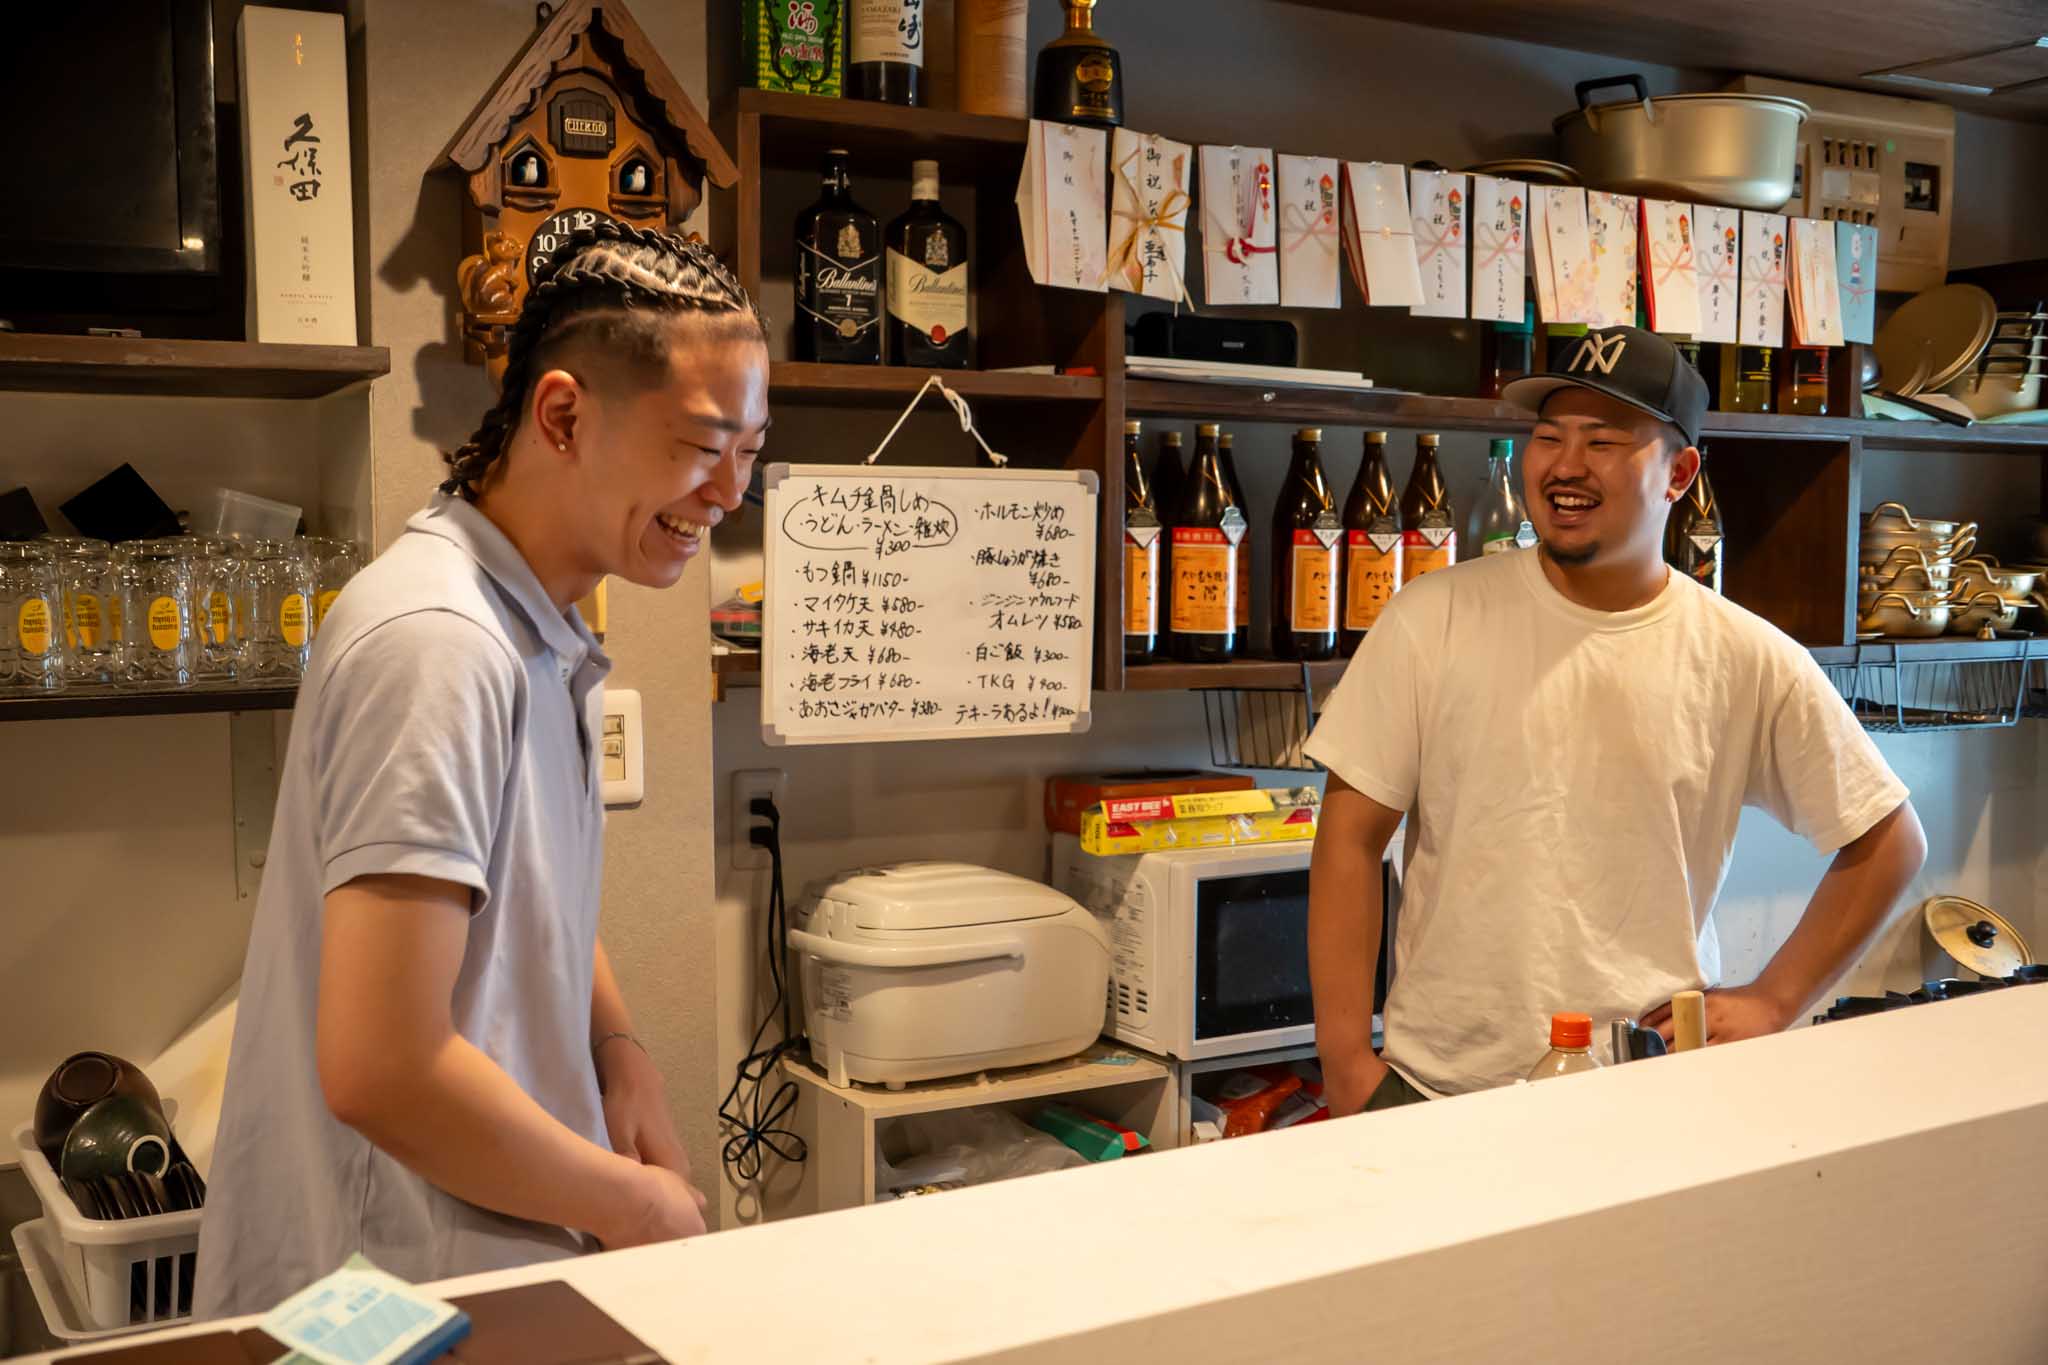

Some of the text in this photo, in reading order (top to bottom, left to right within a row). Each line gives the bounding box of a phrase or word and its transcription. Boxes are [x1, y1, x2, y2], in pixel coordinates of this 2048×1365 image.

[277, 112, 321, 202] 久保田
[1146, 147, 1162, 190] 御祝
[553, 216, 570, 235] 11
[573, 211, 596, 230] 12
[537, 234, 557, 253] 10
[810, 484, 930, 514] キムチ鍋しめ
[980, 501, 1065, 522] ホルモン炒め
[802, 560, 856, 586] もつ鍋
[804, 592, 874, 615] マイタケ天
[803, 618, 874, 639] サキイカ天
[988, 609, 1048, 630] オムレツ
[801, 643, 859, 665] 海老天
[976, 641, 1024, 662] 白ご飯
[799, 672, 872, 692] 海老フライ
[977, 673, 1015, 690] TKG
